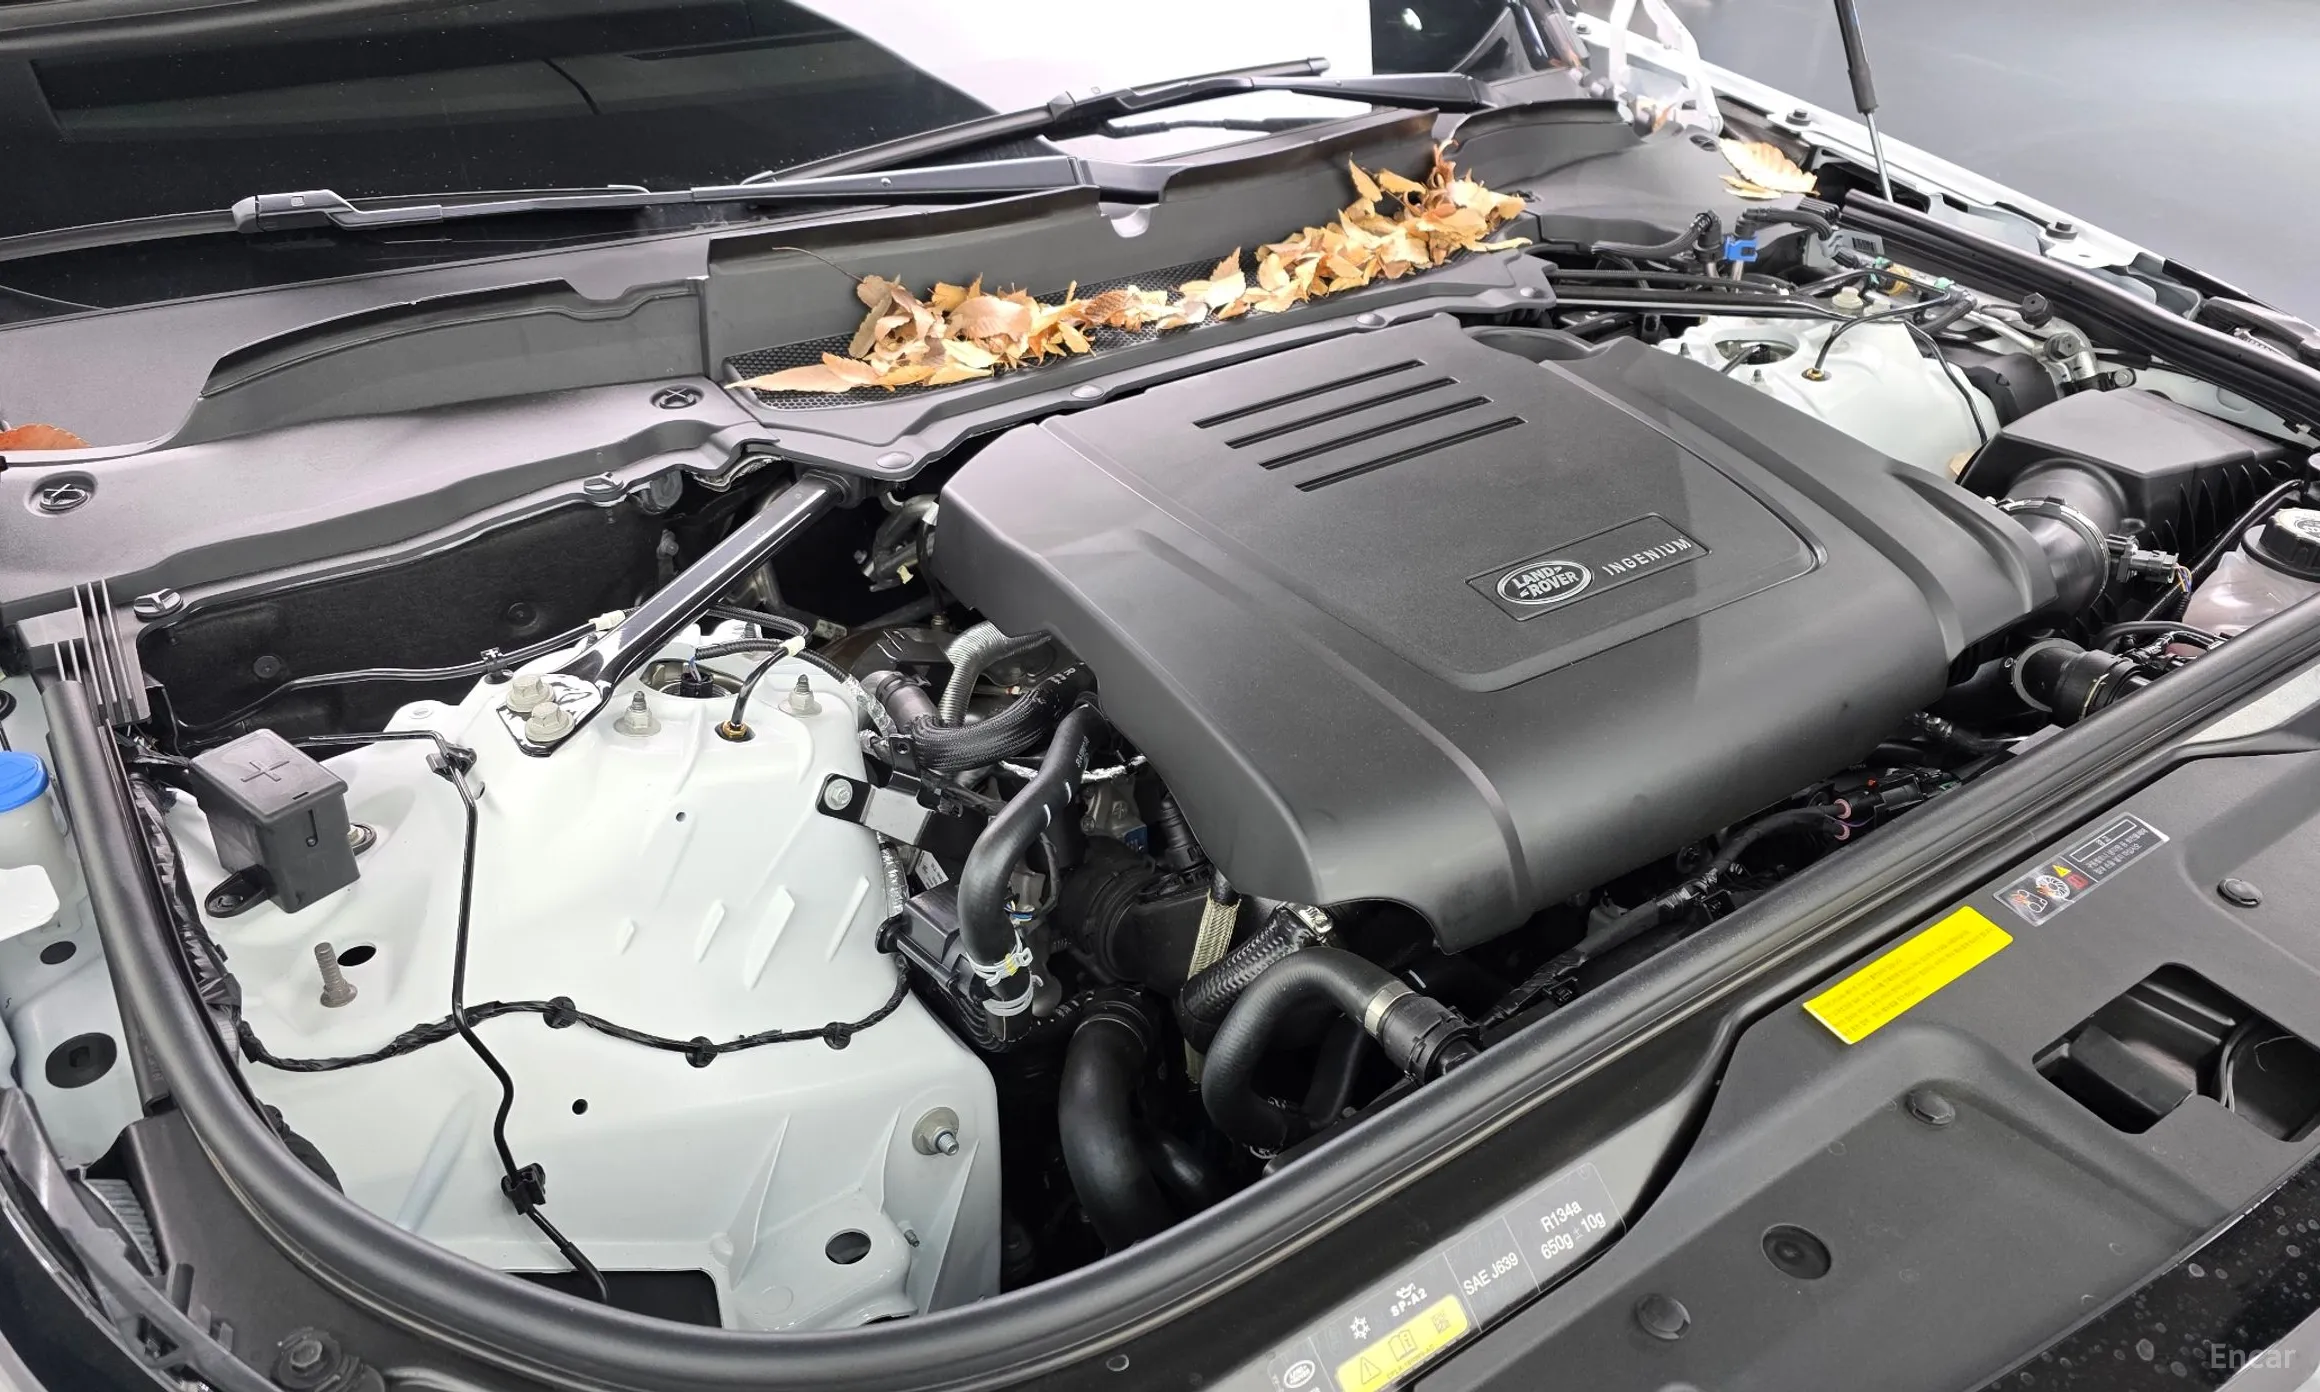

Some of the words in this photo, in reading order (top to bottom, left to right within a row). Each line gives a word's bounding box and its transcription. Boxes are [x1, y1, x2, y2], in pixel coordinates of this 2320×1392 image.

[1602, 537, 1692, 576] INGENIUM
[1511, 567, 1558, 589] LAND
[1529, 571, 1580, 599] ROVER
[1540, 1199, 1582, 1233] R134a
[1540, 1231, 1574, 1260] 650g
[1581, 1210, 1606, 1234] 10g
[1463, 1267, 1490, 1296] SAE
[1490, 1251, 1519, 1281] J639
[1390, 1287, 1428, 1317] SP-A2
